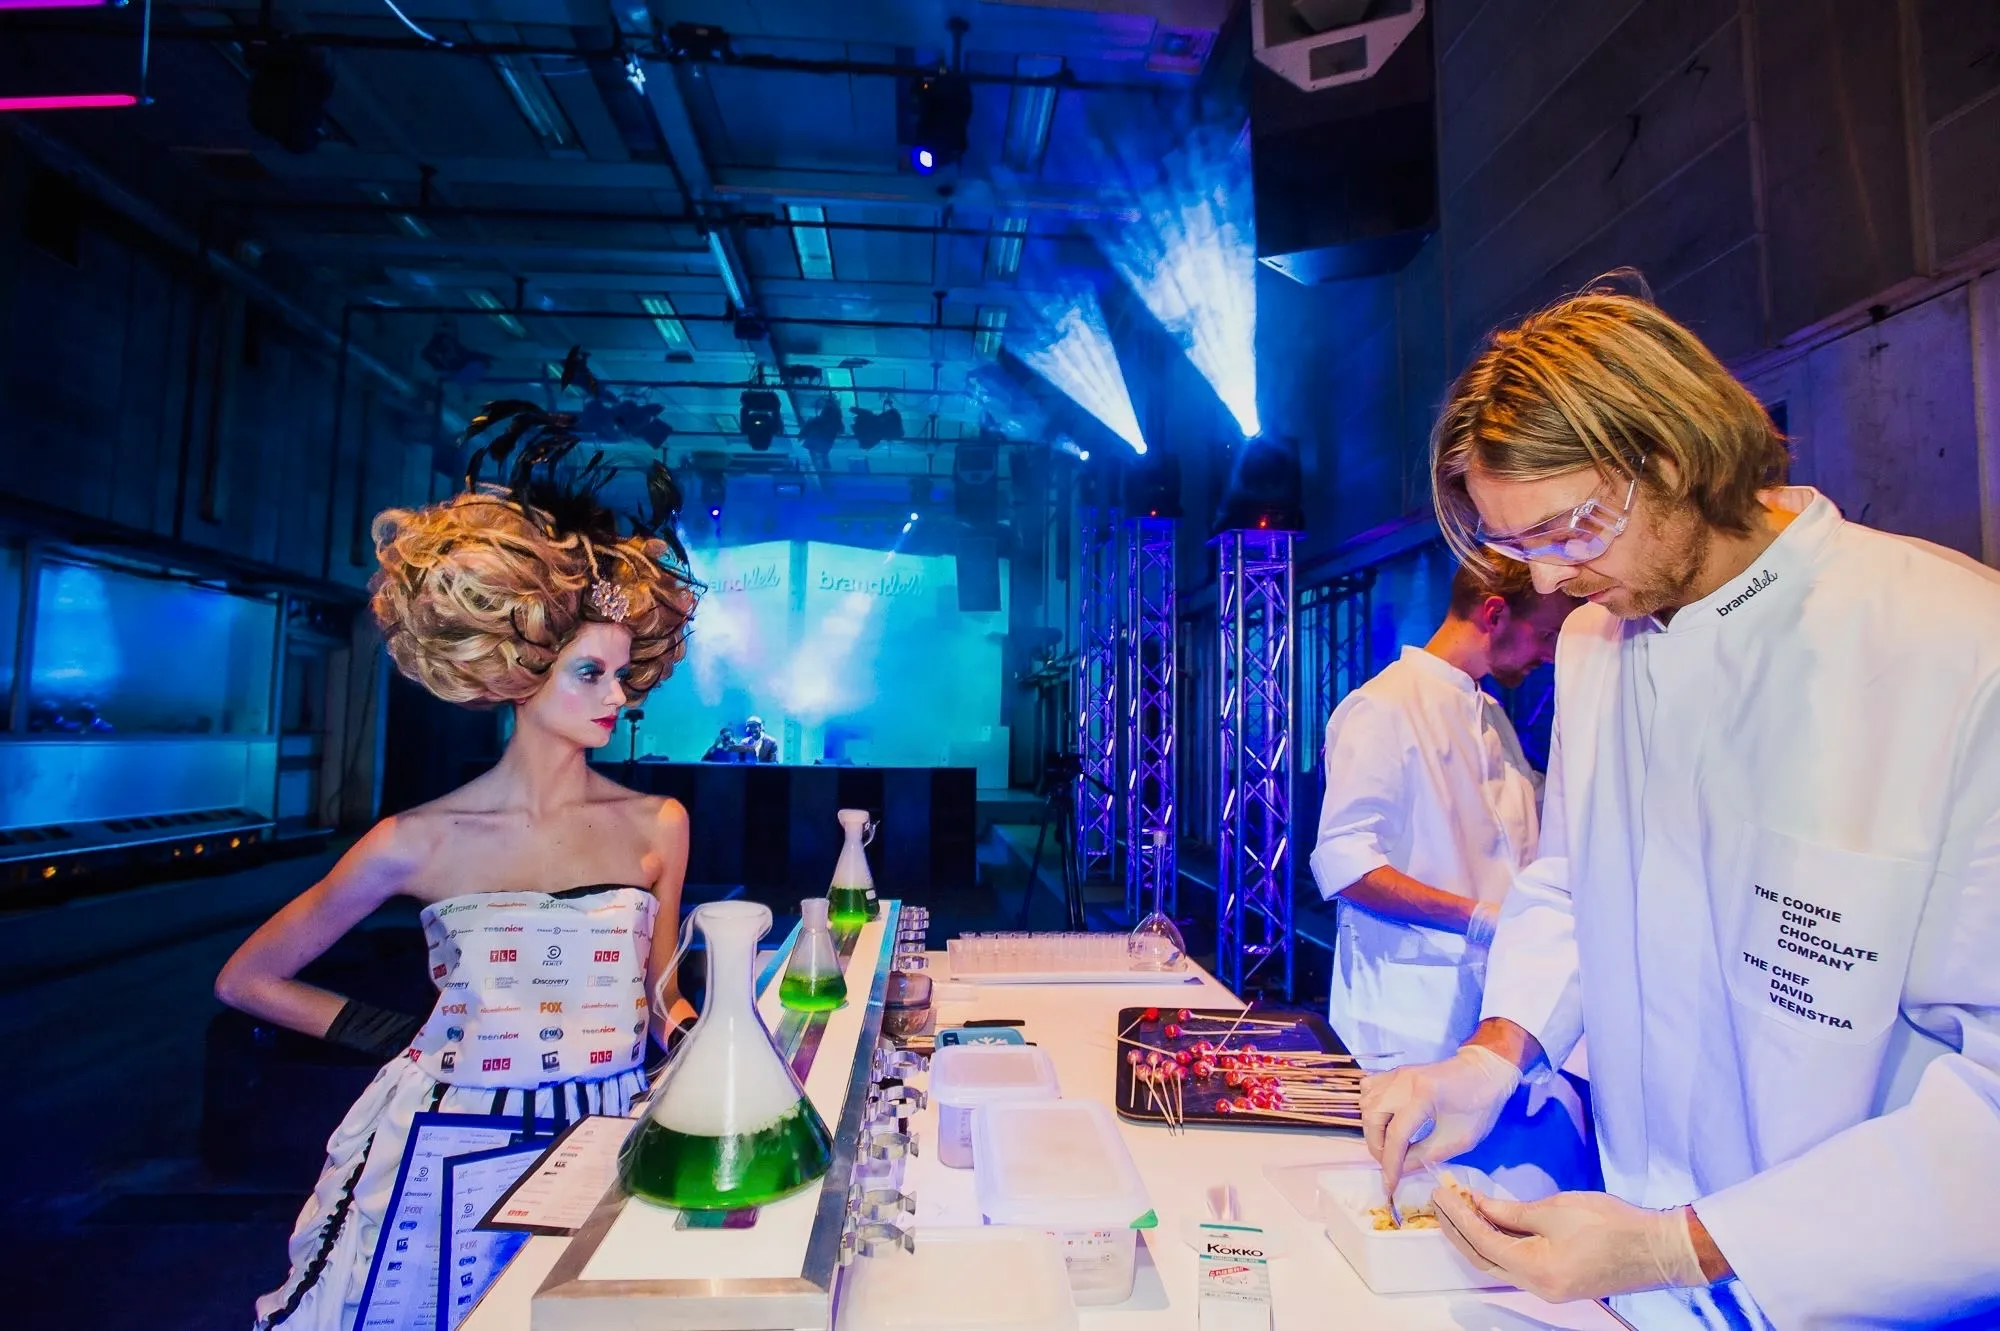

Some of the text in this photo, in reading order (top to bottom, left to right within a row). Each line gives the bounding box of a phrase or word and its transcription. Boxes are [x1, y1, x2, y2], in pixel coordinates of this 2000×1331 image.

[1754, 885, 1842, 924] THE COOKIE
[1781, 910, 1817, 929] CHIP
[1779, 924, 1879, 962] CHOCOLATE
[491, 951, 516, 961] TLC
[594, 951, 619, 962] TLC
[1777, 938, 1855, 972] COMPANY
[1743, 951, 1810, 987] THE CHEF
[1770, 978, 1814, 1004] DAVID
[441, 1003, 467, 1015] FOX
[540, 1002, 563, 1013] FOX
[1769, 992, 1853, 1030] VEENSTRA
[483, 1059, 510, 1070] TLC
[590, 1052, 612, 1063] TLC
